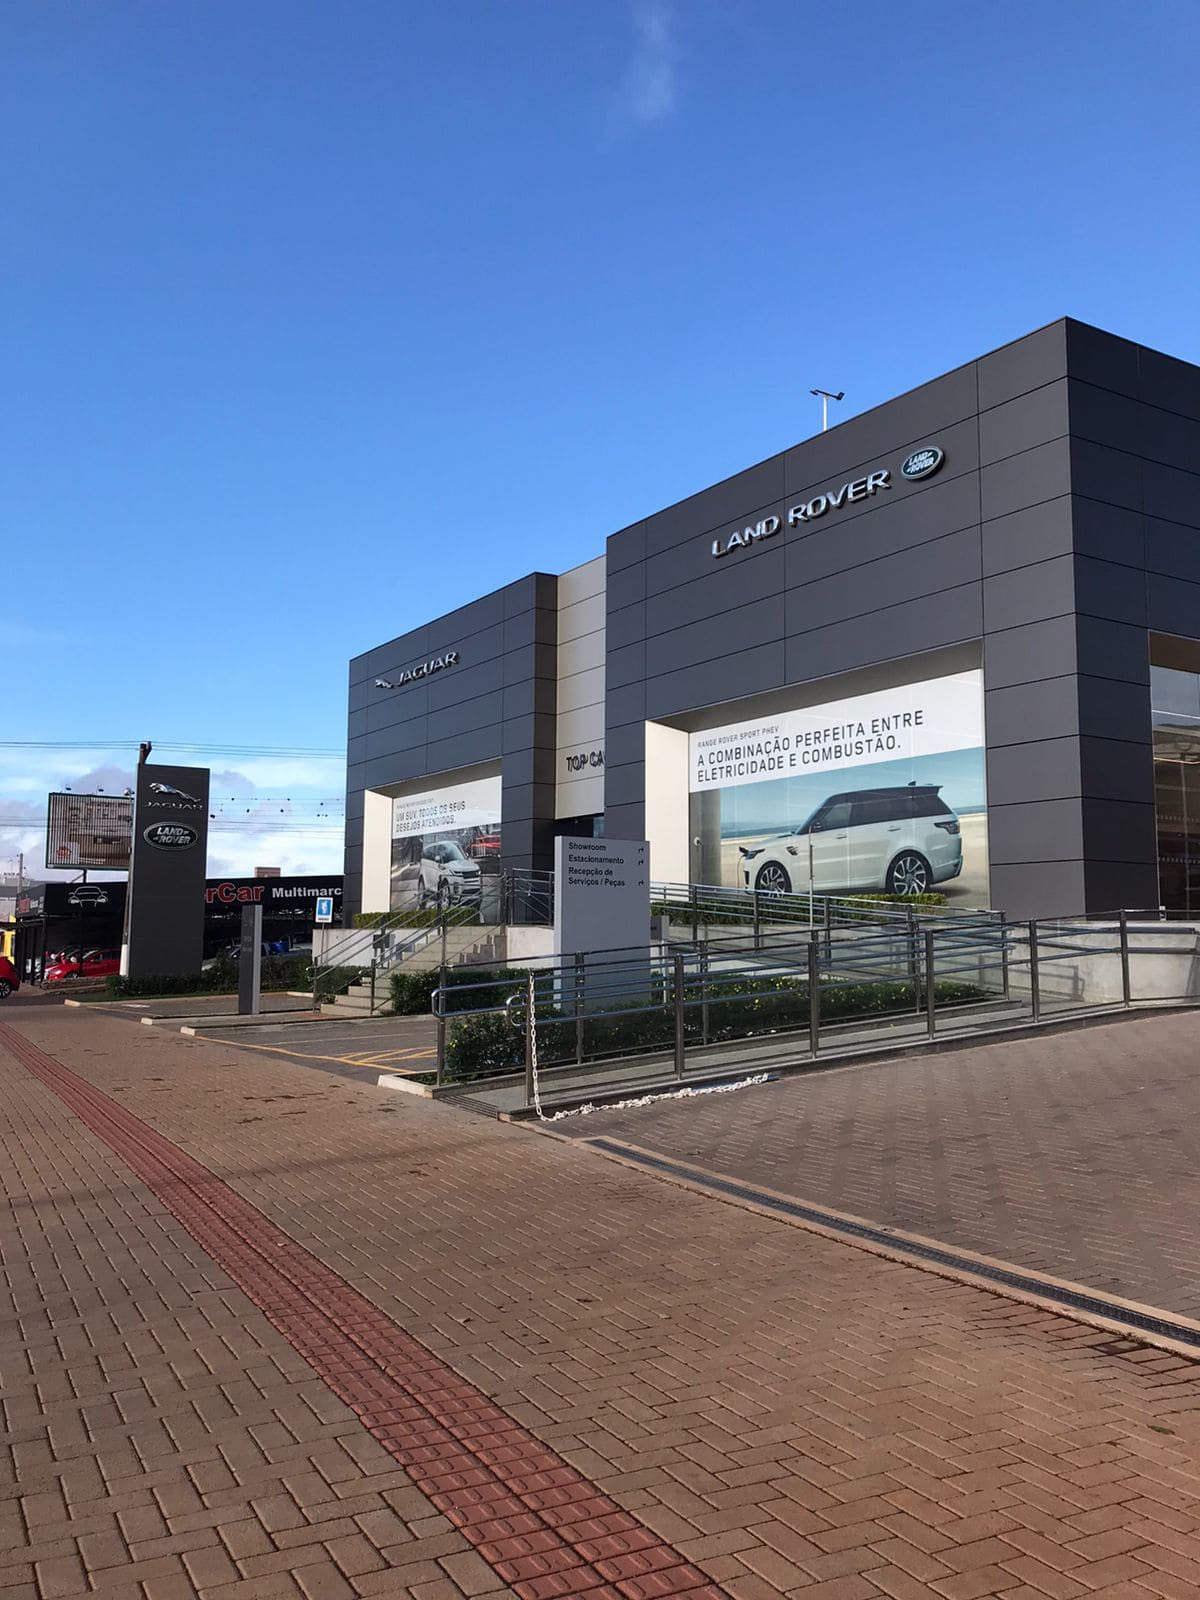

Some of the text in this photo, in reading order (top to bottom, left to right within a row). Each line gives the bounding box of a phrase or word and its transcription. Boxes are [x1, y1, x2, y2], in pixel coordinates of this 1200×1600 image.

[909, 451, 929, 466] LAND
[911, 456, 935, 474] ROVER
[711, 468, 891, 557] LAND ROVER
[398, 651, 458, 686] JAGUAR
[697, 709, 924, 767] A COMBINAÇÃO PERFEITA ENTRE
[718, 732, 738, 745] ROVER
[739, 729, 761, 741] SPORT
[762, 725, 780, 737] PHEV
[566, 753, 589, 773] TOP
[697, 732, 902, 783] ELETRICIDADE E COMBUSTÃO.
[449, 800, 466, 813] SEUS
[157, 827, 184, 836] LAND
[158, 835, 191, 844] ROVER
[568, 841, 607, 851] Showroom
[568, 854, 625, 865] Estacionamento
[568, 866, 603, 877] Recepção
[568, 877, 599, 887] Serviços
[604, 878, 626, 888] Peças
